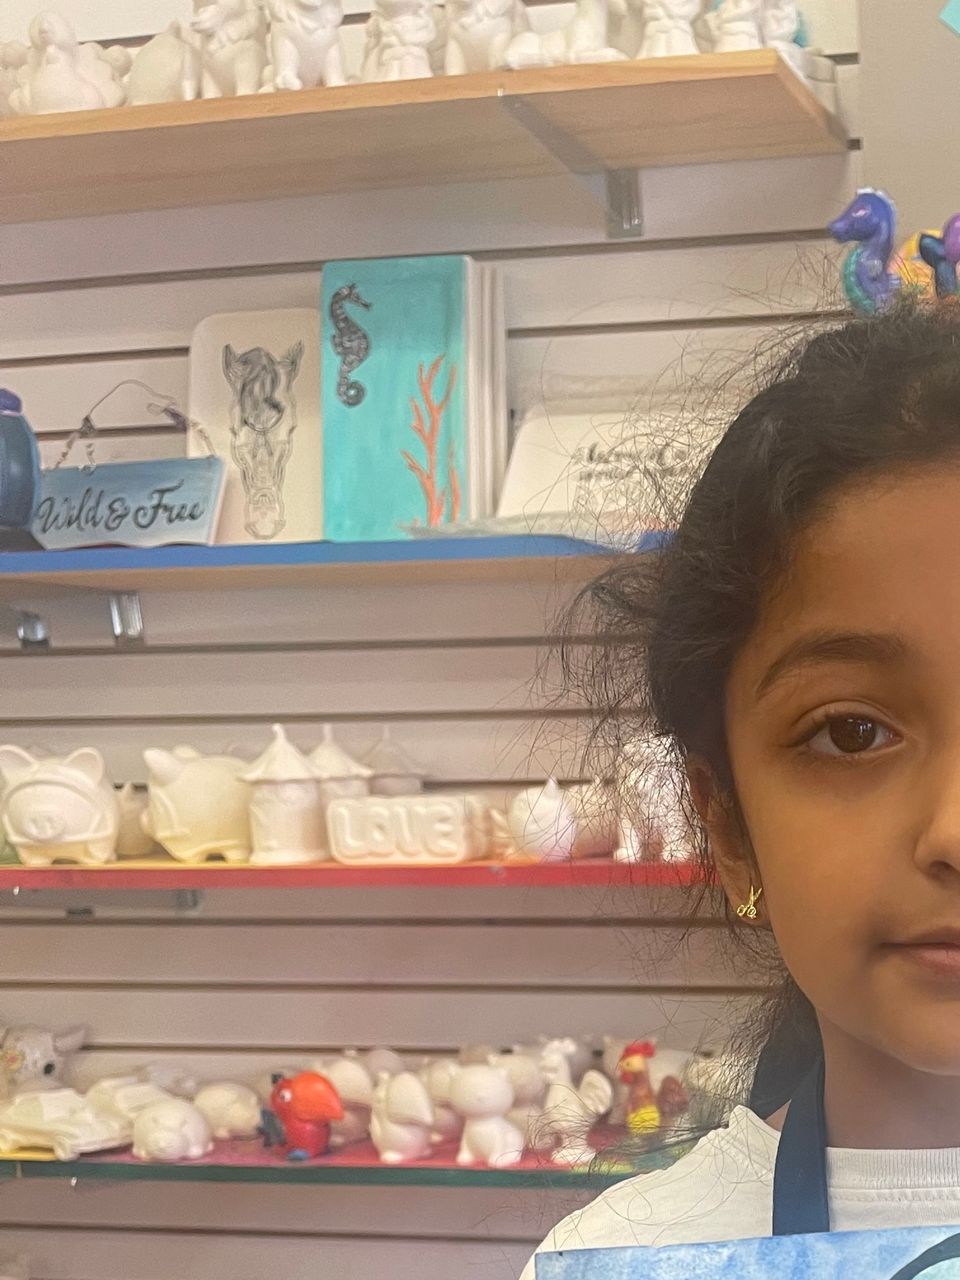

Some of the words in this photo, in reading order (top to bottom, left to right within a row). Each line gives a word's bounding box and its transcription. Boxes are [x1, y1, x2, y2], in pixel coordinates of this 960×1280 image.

[34, 487, 105, 534] Wild
[104, 497, 130, 531] &
[133, 479, 206, 529] Free
[333, 804, 461, 859] LOVE
